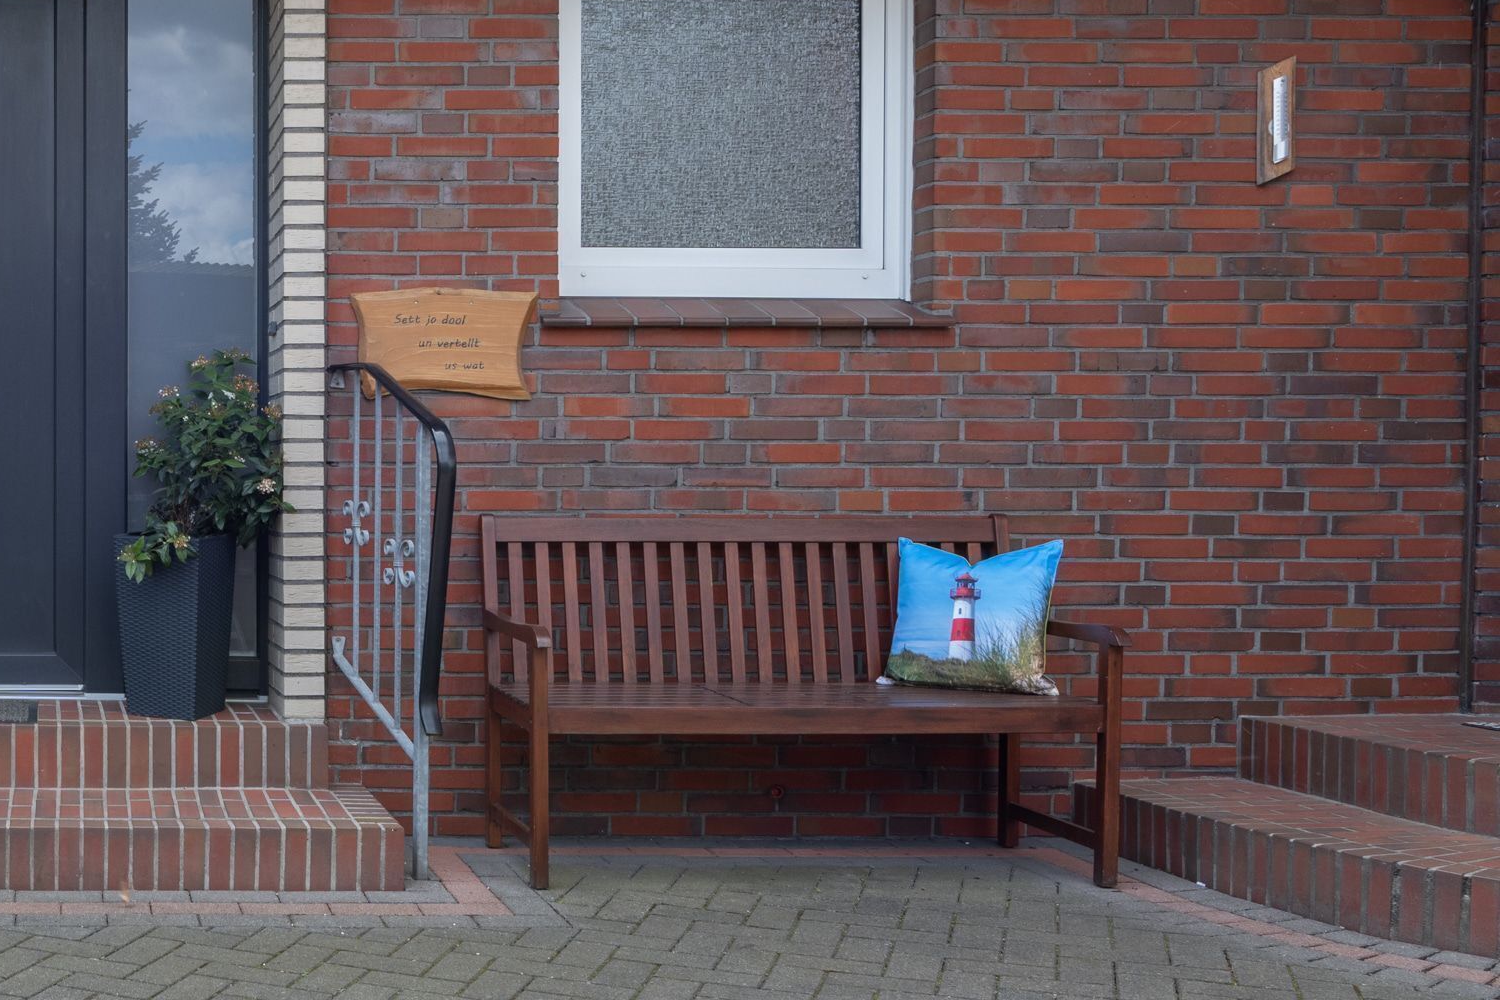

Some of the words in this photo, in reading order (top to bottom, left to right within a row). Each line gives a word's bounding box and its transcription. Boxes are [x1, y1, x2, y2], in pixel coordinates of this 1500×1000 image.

[394, 313, 421, 325] Sett
[425, 315, 437, 326] jo
[418, 340, 432, 348] un
[437, 338, 481, 349] vertellt
[445, 362, 458, 370] us
[463, 361, 485, 370] wat
